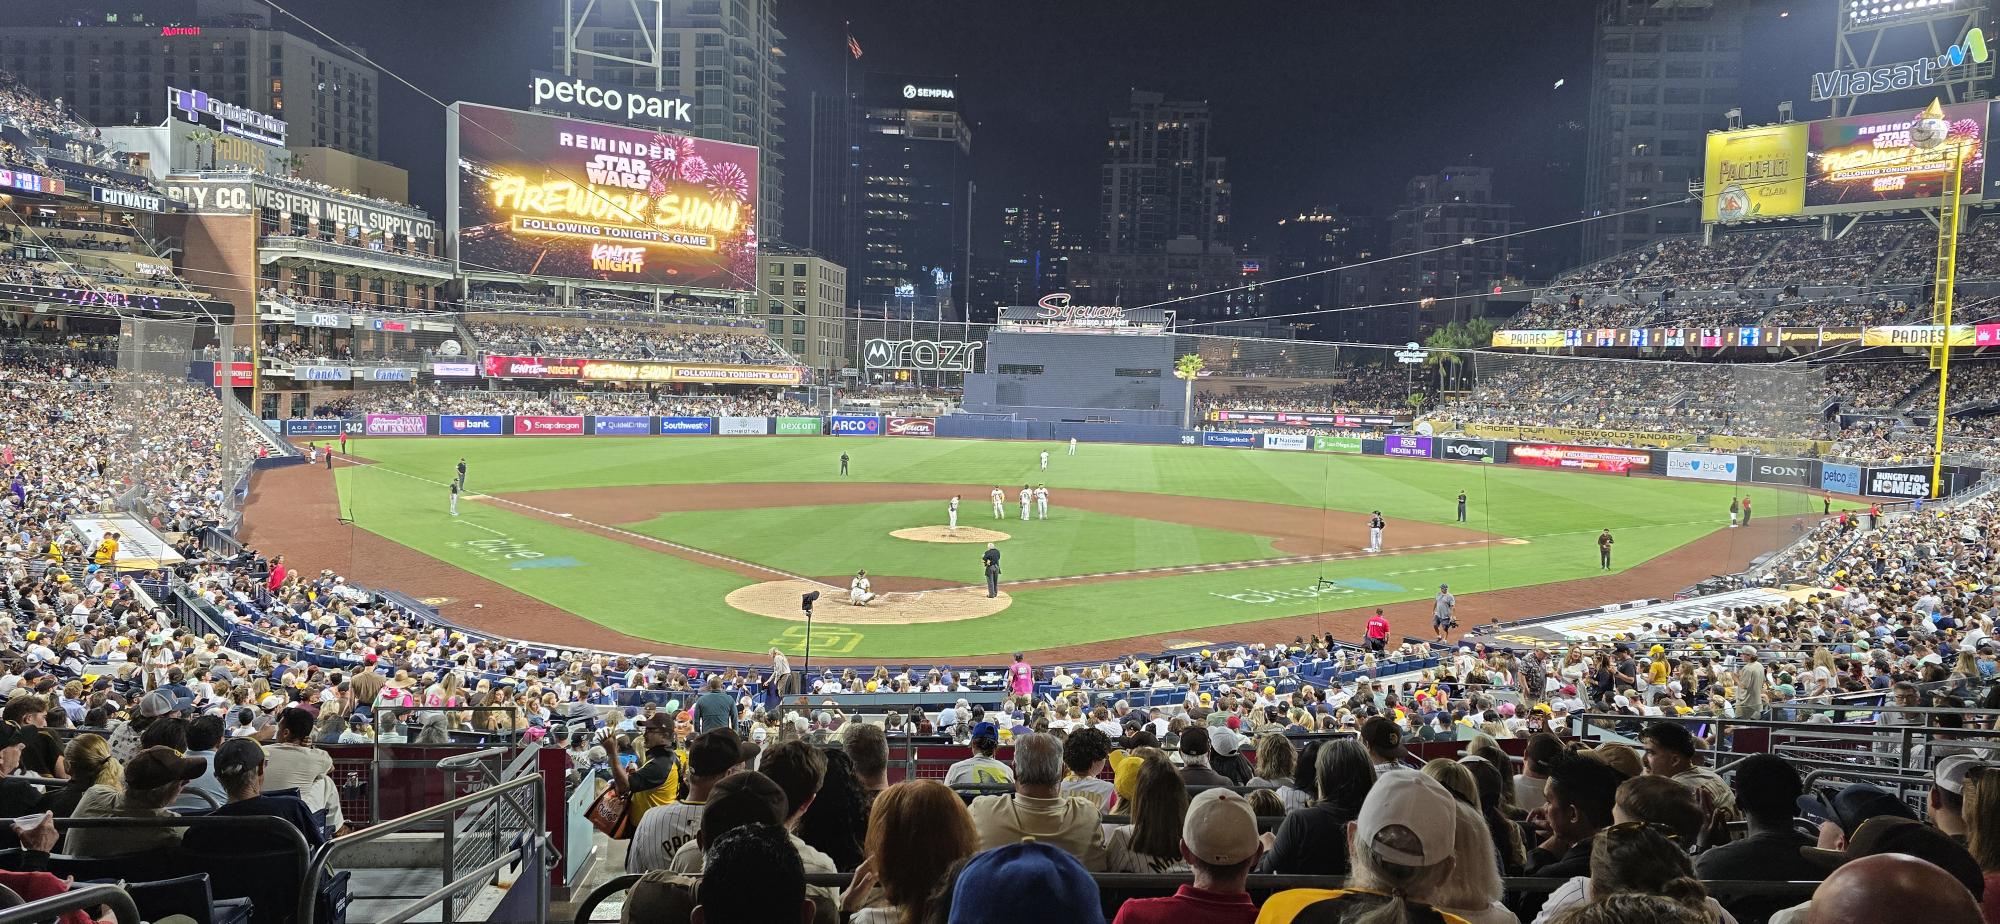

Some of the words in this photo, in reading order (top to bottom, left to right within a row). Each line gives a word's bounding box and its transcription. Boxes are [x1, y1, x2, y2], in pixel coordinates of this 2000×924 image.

[1815, 58, 1933, 99] Viasat
[917, 88, 954, 98] SEMPRA
[534, 77, 622, 111] petco
[628, 94, 691, 123] park
[560, 132, 676, 160] REMINDER
[216, 138, 265, 171] PADRES
[586, 154, 651, 176] STAR
[1837, 169, 1880, 178] FOLLOWING
[1882, 165, 1919, 174] TONIGHT'S
[586, 168, 651, 190] WARS
[102, 188, 159, 211] CUTWATER
[216, 187, 252, 210] CO.
[254, 186, 320, 218] WESTERN
[326, 203, 367, 227] METAL
[369, 213, 412, 236] SUPPLY
[416, 222, 434, 240] CO.
[656, 196, 740, 234] SHOW
[523, 218, 601, 236] FOLLOWING
[604, 225, 671, 242] TONIGHT'S
[673, 233, 708, 247] GAME
[591, 243, 646, 265] IGNITE
[592, 258, 641, 273] NIGHT
[1037, 293, 1126, 325] Sycuan
[312, 313, 338, 327] ORIS
[1511, 333, 1547, 345] PADRES
[1891, 329, 1945, 343] PADRES
[895, 339, 983, 370] razr
[548, 366, 580, 375] NIGHT
[678, 369, 727, 378] FOLLOWING
[728, 371, 770, 379] TONIGHT'S
[262, 379, 275, 391] 336
[345, 422, 363, 433] 342
[369, 424, 424, 434] CALIFORNIA
[454, 420, 466, 428] us
[467, 420, 490, 428] bank
[535, 422, 579, 431] Snapdragon
[608, 421, 648, 430] QuidelOrtho
[663, 421, 702, 429] Southwest
[832, 420, 866, 431] ARCO
[890, 419, 930, 434] Sycuan
[1474, 424, 1514, 433] CHROME
[1181, 434, 1195, 445] 396
[1601, 431, 1626, 439] GOLD
[1628, 432, 1683, 441] STANDARD
[1391, 447, 1412, 455] NEXEN
[1446, 444, 1488, 456] EVOTEK
[1669, 459, 1691, 468] blue
[1703, 461, 1725, 471] blue
[1760, 465, 1807, 477] SONY
[1824, 470, 1846, 483] petco
[1876, 472, 1909, 481] HUNGRY
[1909, 474, 1926, 483] FOR
[1872, 479, 1930, 497] HOMERS
